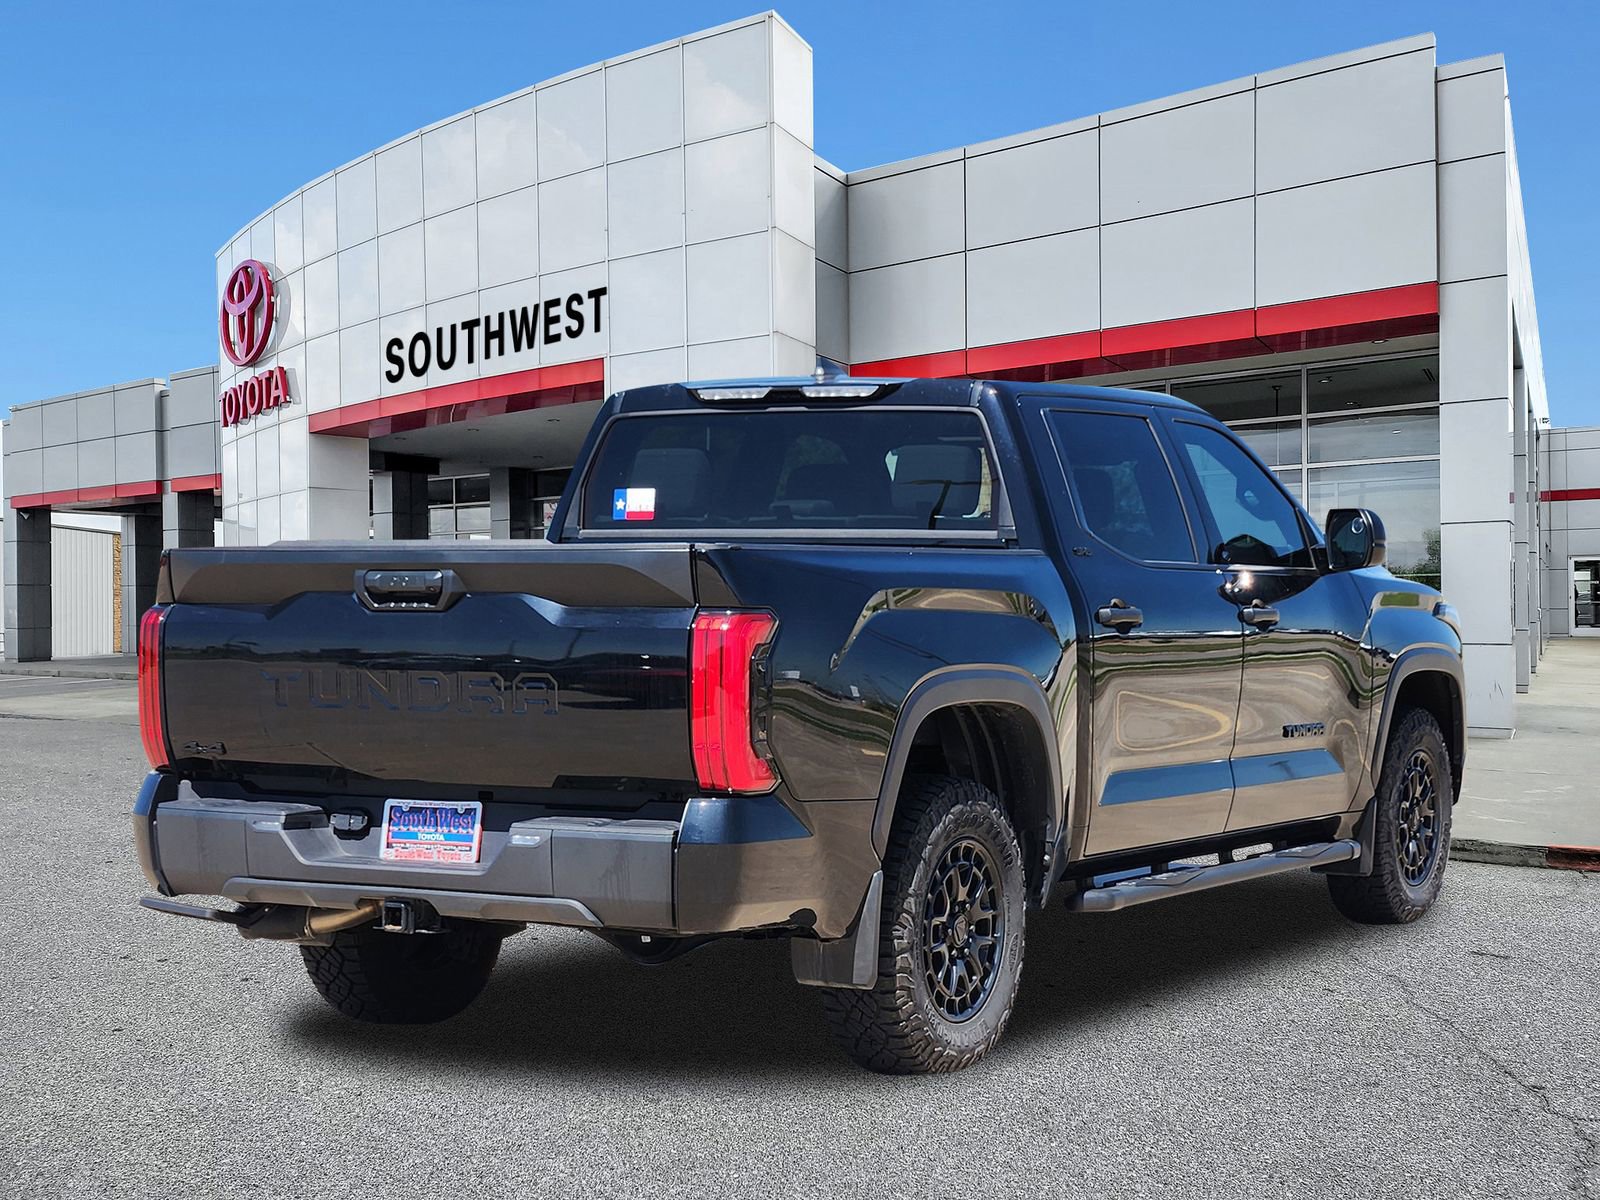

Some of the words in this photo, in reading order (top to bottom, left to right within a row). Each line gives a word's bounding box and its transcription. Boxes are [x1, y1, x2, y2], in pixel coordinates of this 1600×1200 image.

[385, 287, 608, 384] SOUTHWEST
[218, 366, 291, 428] TOYOTA
[260, 669, 558, 715] TUNDRA
[417, 833, 445, 841] TOYOTA
